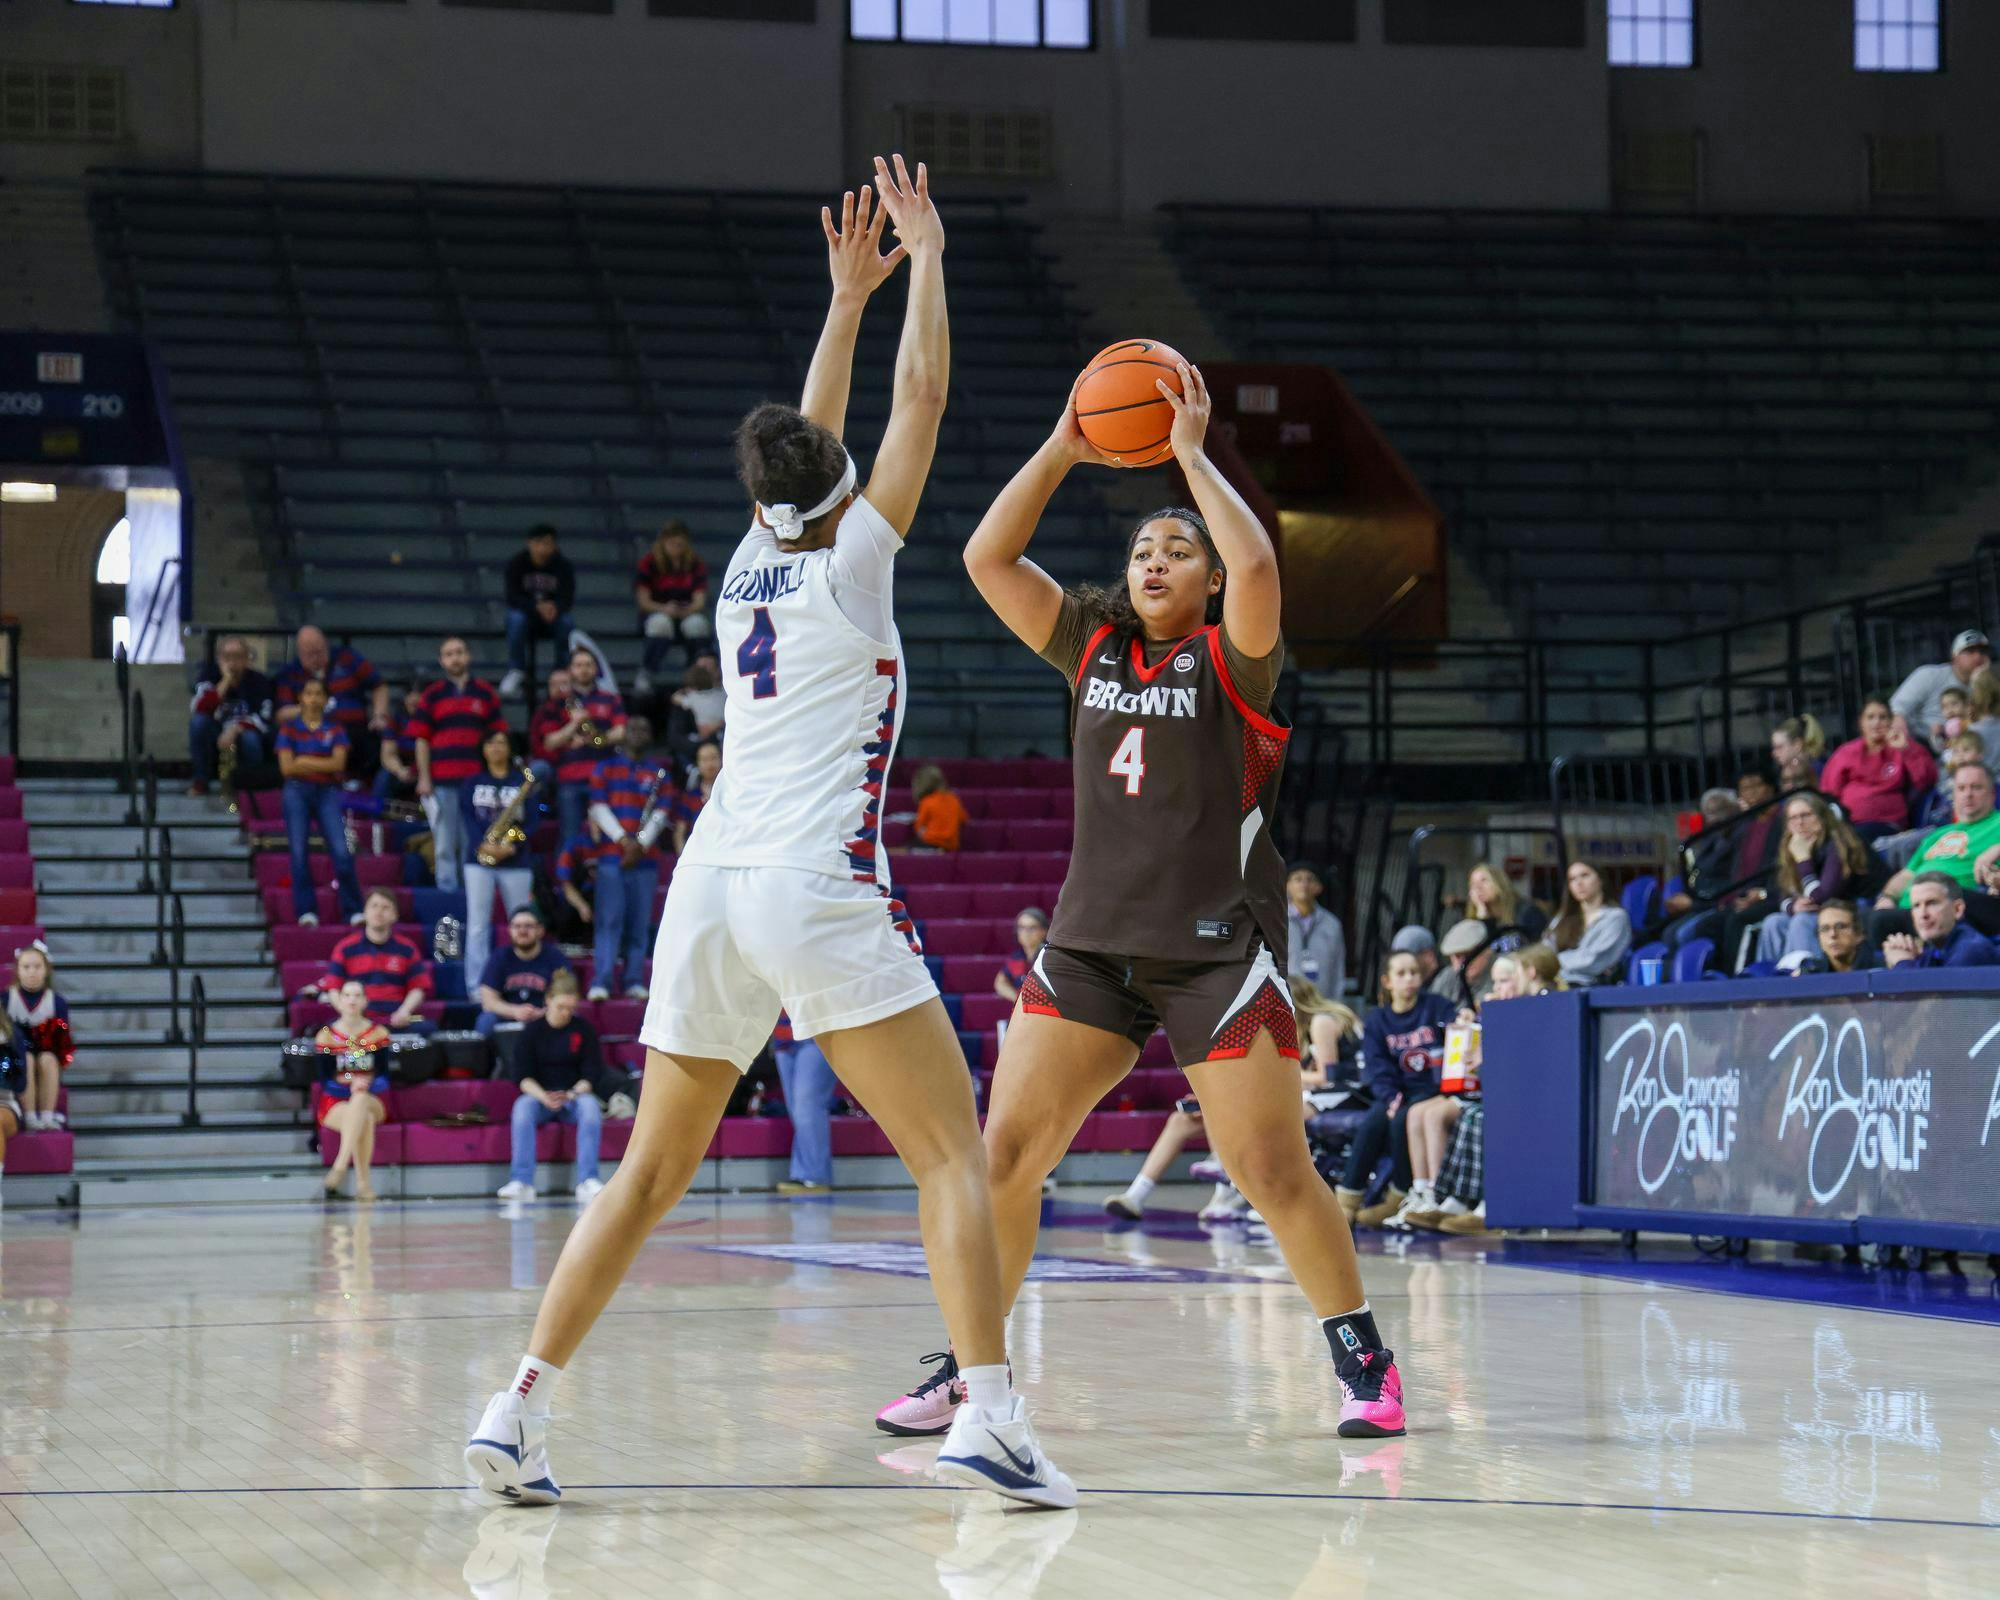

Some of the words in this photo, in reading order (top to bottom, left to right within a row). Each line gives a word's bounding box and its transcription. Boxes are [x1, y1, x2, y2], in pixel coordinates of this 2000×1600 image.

[82, 394, 123, 418] 210
[737, 606, 778, 700] 4
[1083, 677, 1197, 718] BROWN
[1108, 725, 1146, 796] 4
[1604, 1017, 1659, 1136] Ron
[1768, 1012, 1832, 1141] Ron
[1680, 1111, 1738, 1162] GOLF
[1859, 1110, 1929, 1172] GOLF
